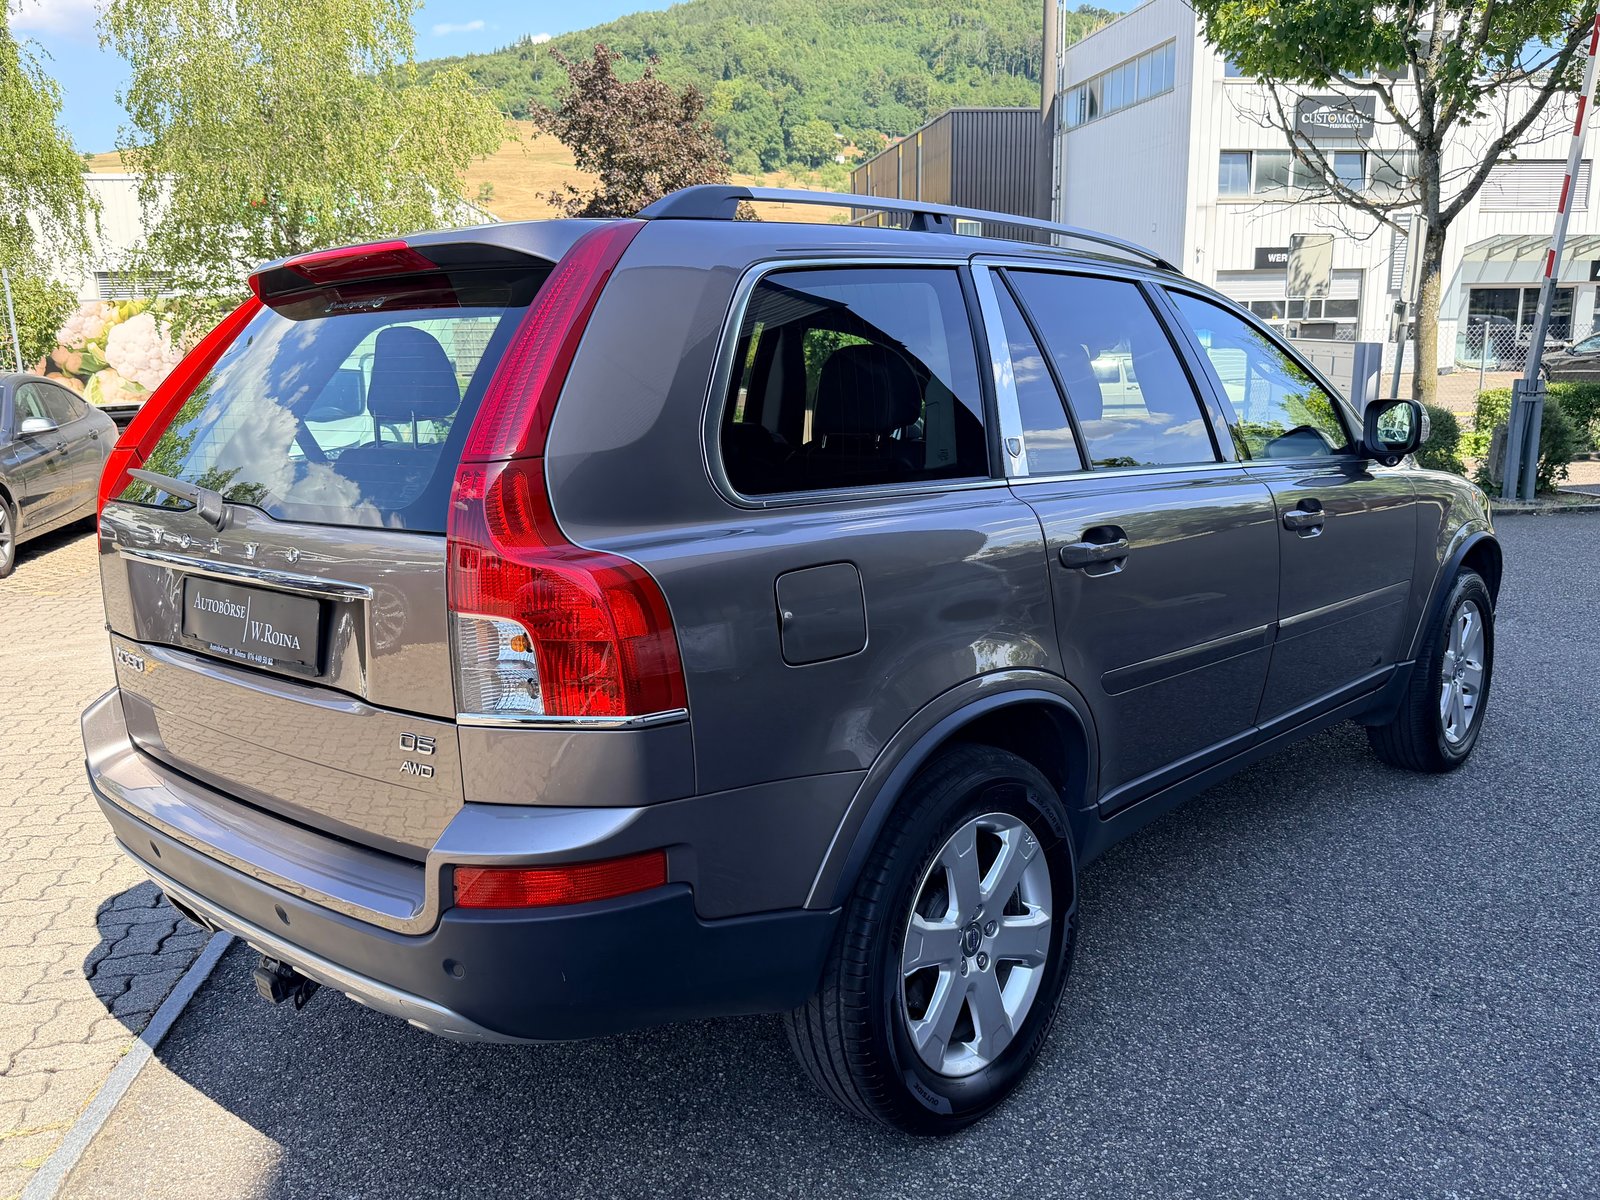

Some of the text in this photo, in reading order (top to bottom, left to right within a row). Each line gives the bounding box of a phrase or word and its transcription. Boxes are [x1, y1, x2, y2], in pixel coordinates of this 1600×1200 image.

[151, 528, 300, 565] VOLVO
[399, 732, 435, 755] D5
[399, 760, 434, 778] AWD
[912, 1082, 939, 1106] OUTSIDE
